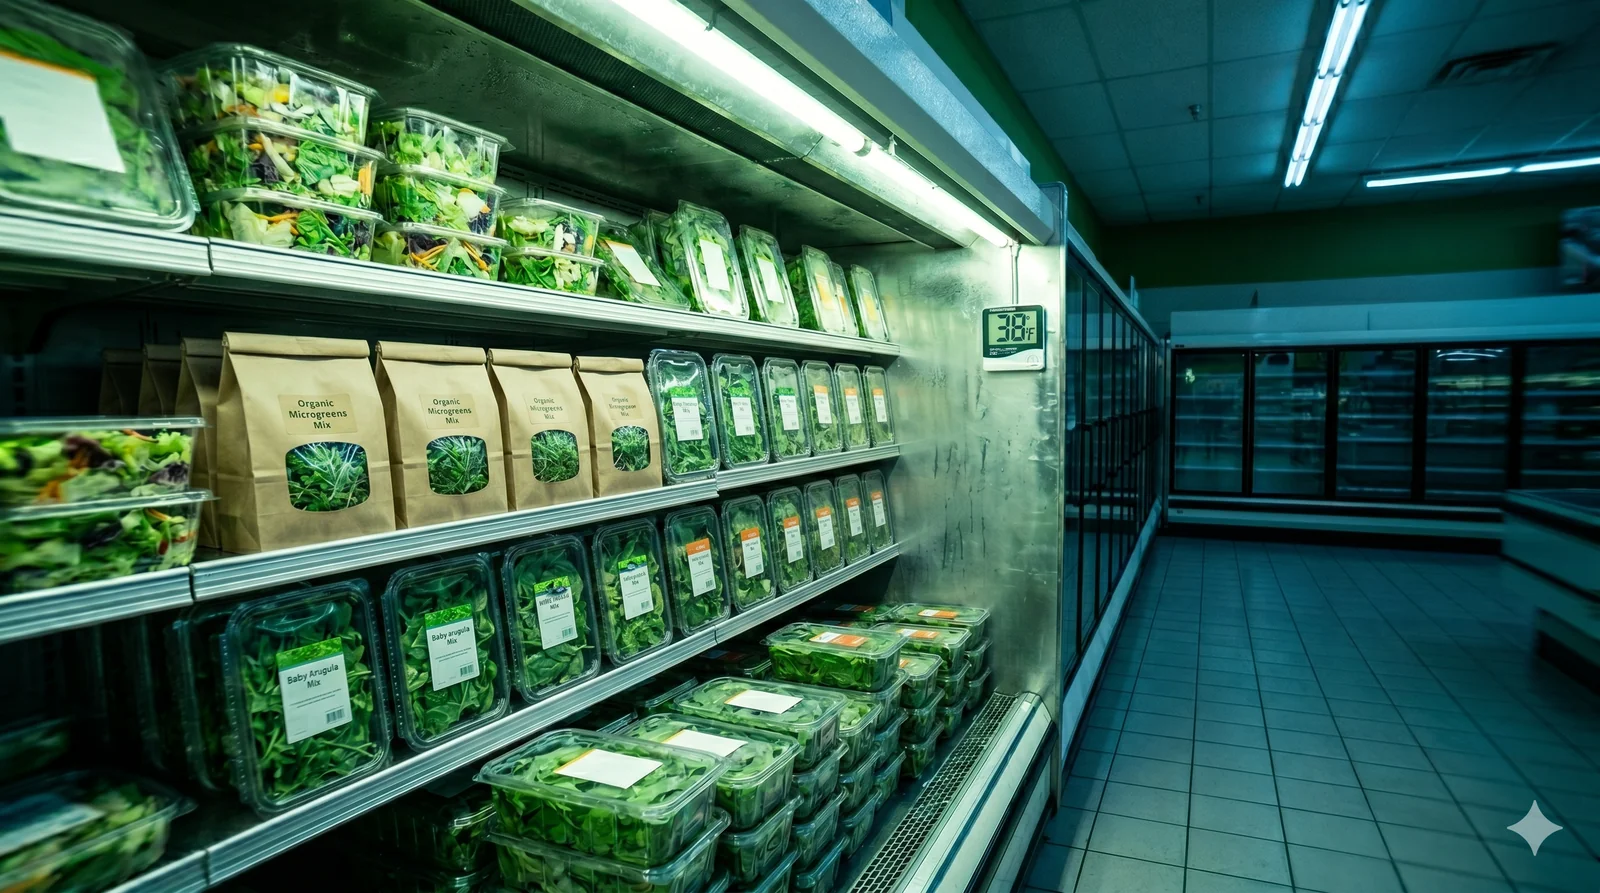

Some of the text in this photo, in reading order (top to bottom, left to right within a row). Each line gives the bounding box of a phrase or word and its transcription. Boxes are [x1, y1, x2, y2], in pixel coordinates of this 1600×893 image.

[297, 399, 334, 409] Organic
[432, 397, 460, 407] Organic
[288, 410, 348, 421] Microgreens
[427, 407, 472, 417] Microgreens
[313, 421, 332, 429] Mix
[431, 625, 470, 642] Baby arugula
[446, 638, 458, 646] Mix
[287, 663, 339, 685] Baby Arugula
[307, 679, 321, 689] Mix
